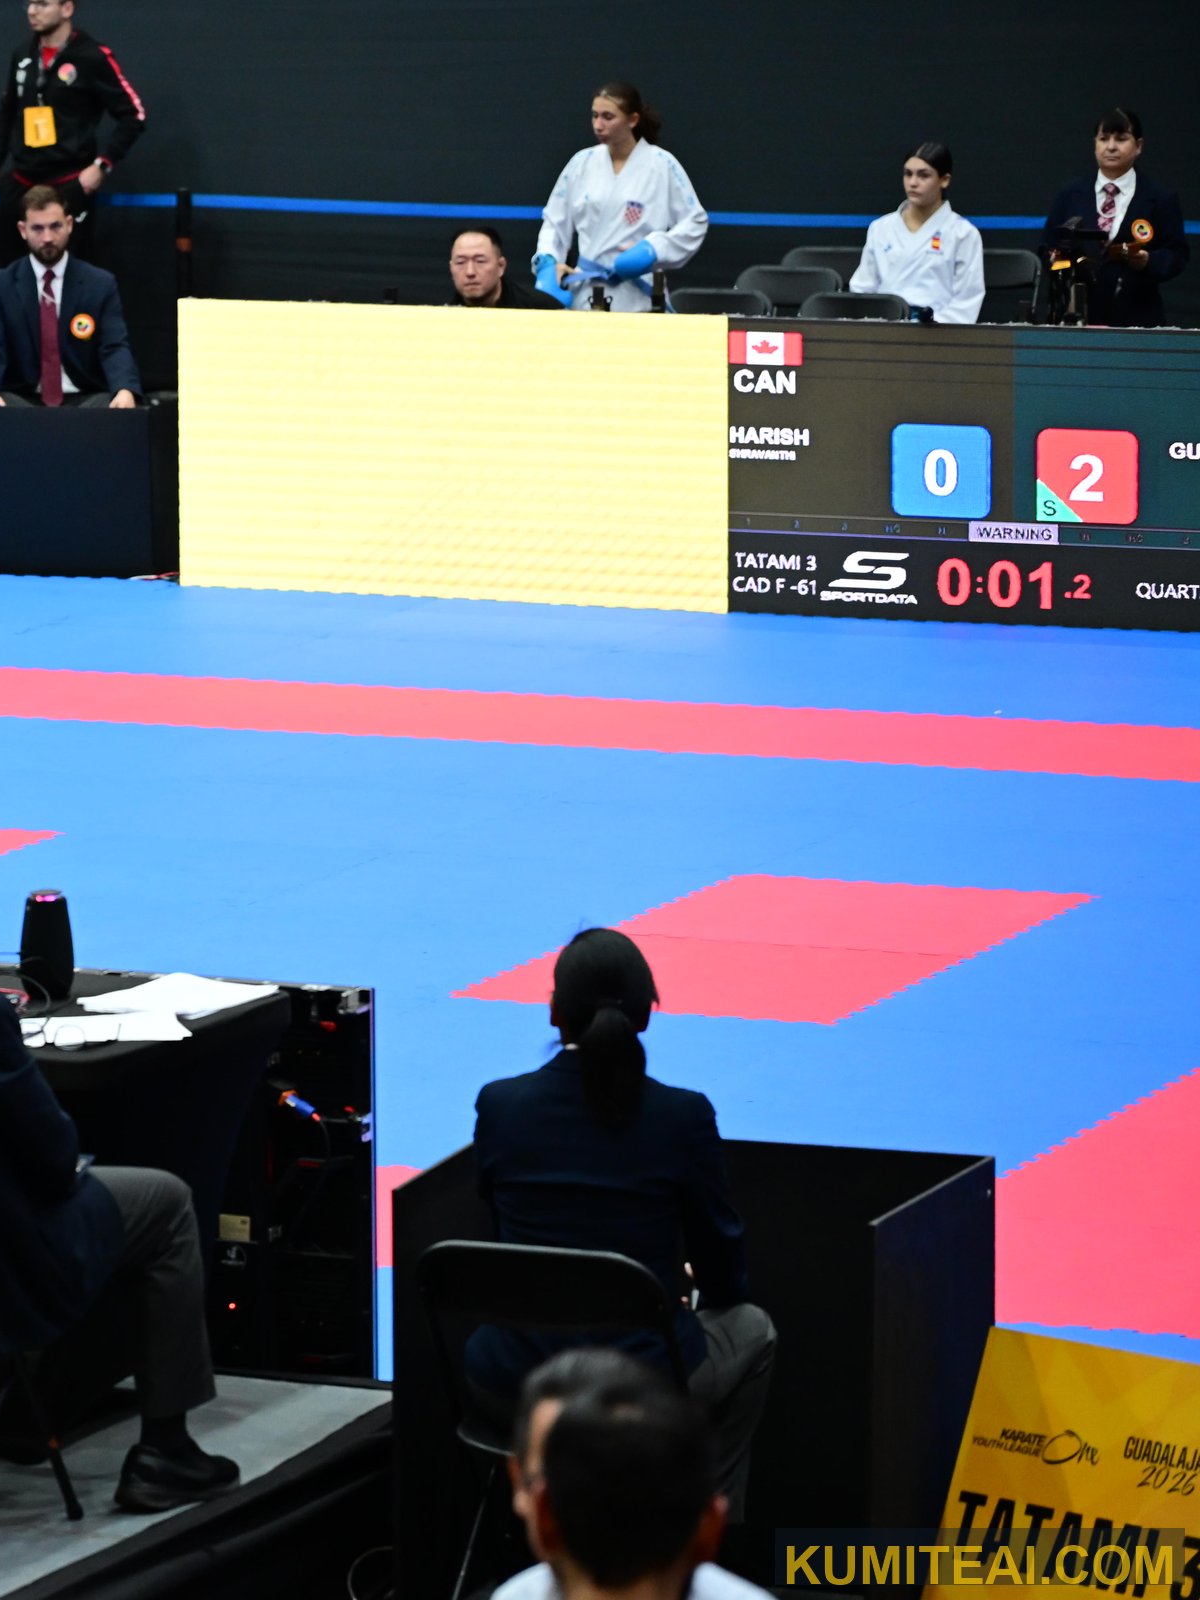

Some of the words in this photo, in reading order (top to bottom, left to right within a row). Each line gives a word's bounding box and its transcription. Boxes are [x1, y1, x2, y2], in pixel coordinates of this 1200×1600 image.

[733, 368, 797, 394] CAN
[729, 425, 810, 446] HARISH
[923, 448, 959, 497] 0
[1068, 453, 1105, 503] 2
[1042, 499, 1057, 517] S
[976, 525, 1053, 542] WARNING
[734, 551, 801, 571] TATAMI
[805, 554, 818, 572] 3
[731, 576, 771, 594] CAD
[775, 578, 787, 594] F
[789, 579, 818, 596] -61
[1135, 582, 1200, 600] QUART
[819, 590, 919, 606] SPORTDATA
[1000, 1427, 1047, 1447] KARATE
[1136, 1465, 1198, 1497] 2026
[953, 1489, 1160, 1599] TATAMI
